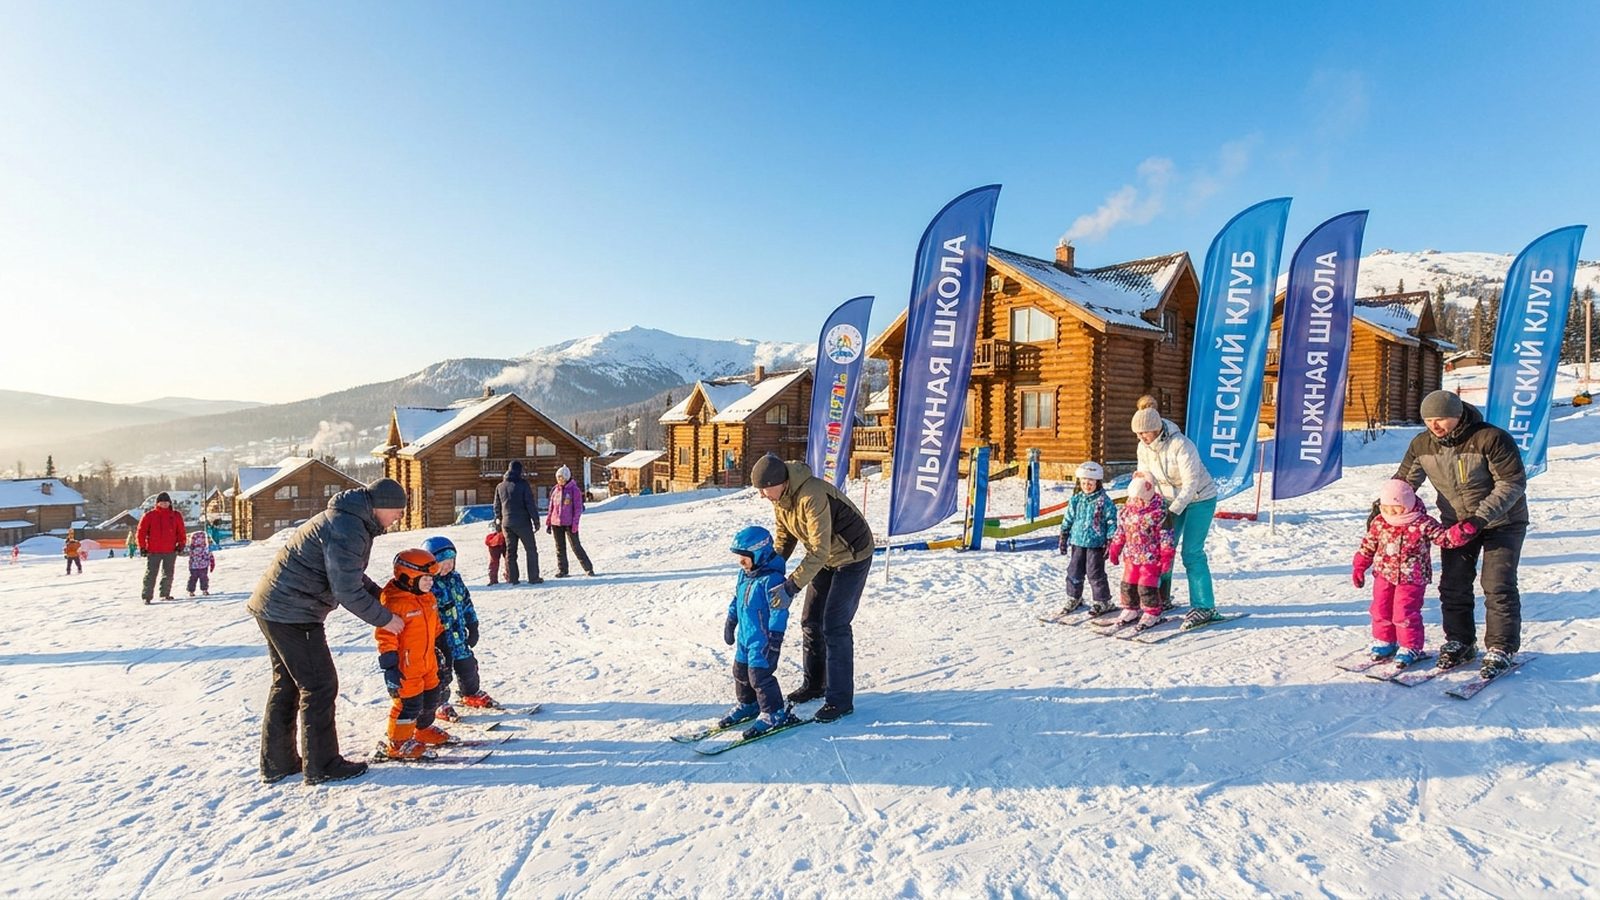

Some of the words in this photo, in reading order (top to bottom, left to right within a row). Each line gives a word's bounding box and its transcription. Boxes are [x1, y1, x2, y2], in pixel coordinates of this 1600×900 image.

[931, 235, 967, 348] ШКОЛА
[1225, 250, 1255, 324] КЛУБ
[1308, 251, 1337, 343] ШКОЛА
[1523, 268, 1554, 332] КЛУБ
[916, 357, 953, 497] ЛЫЖНАЯ
[1210, 334, 1247, 463] ДЕТСКИЙ
[1300, 351, 1329, 465] ЛЫЖНАЯ
